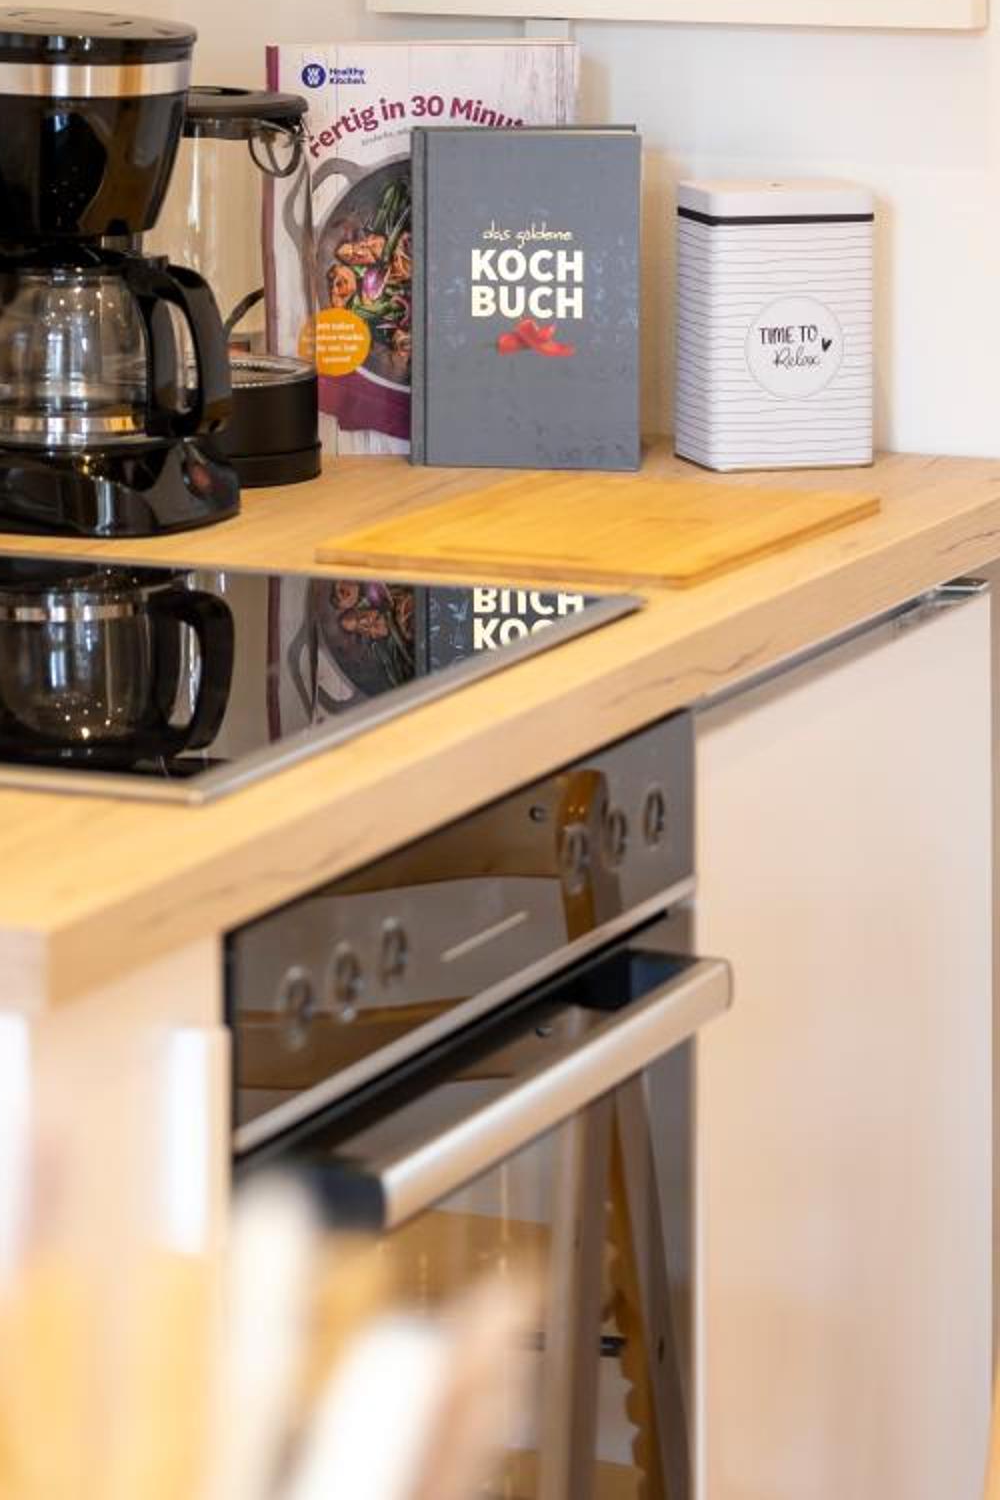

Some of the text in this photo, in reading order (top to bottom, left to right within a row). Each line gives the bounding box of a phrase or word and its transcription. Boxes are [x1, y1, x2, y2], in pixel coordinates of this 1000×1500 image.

[380, 98, 405, 120] in
[411, 95, 444, 117] 30
[482, 219, 573, 249] das goldene
[471, 248, 583, 283] KOCH
[471, 285, 583, 319] BUCH
[759, 324, 818, 345] TIME TO
